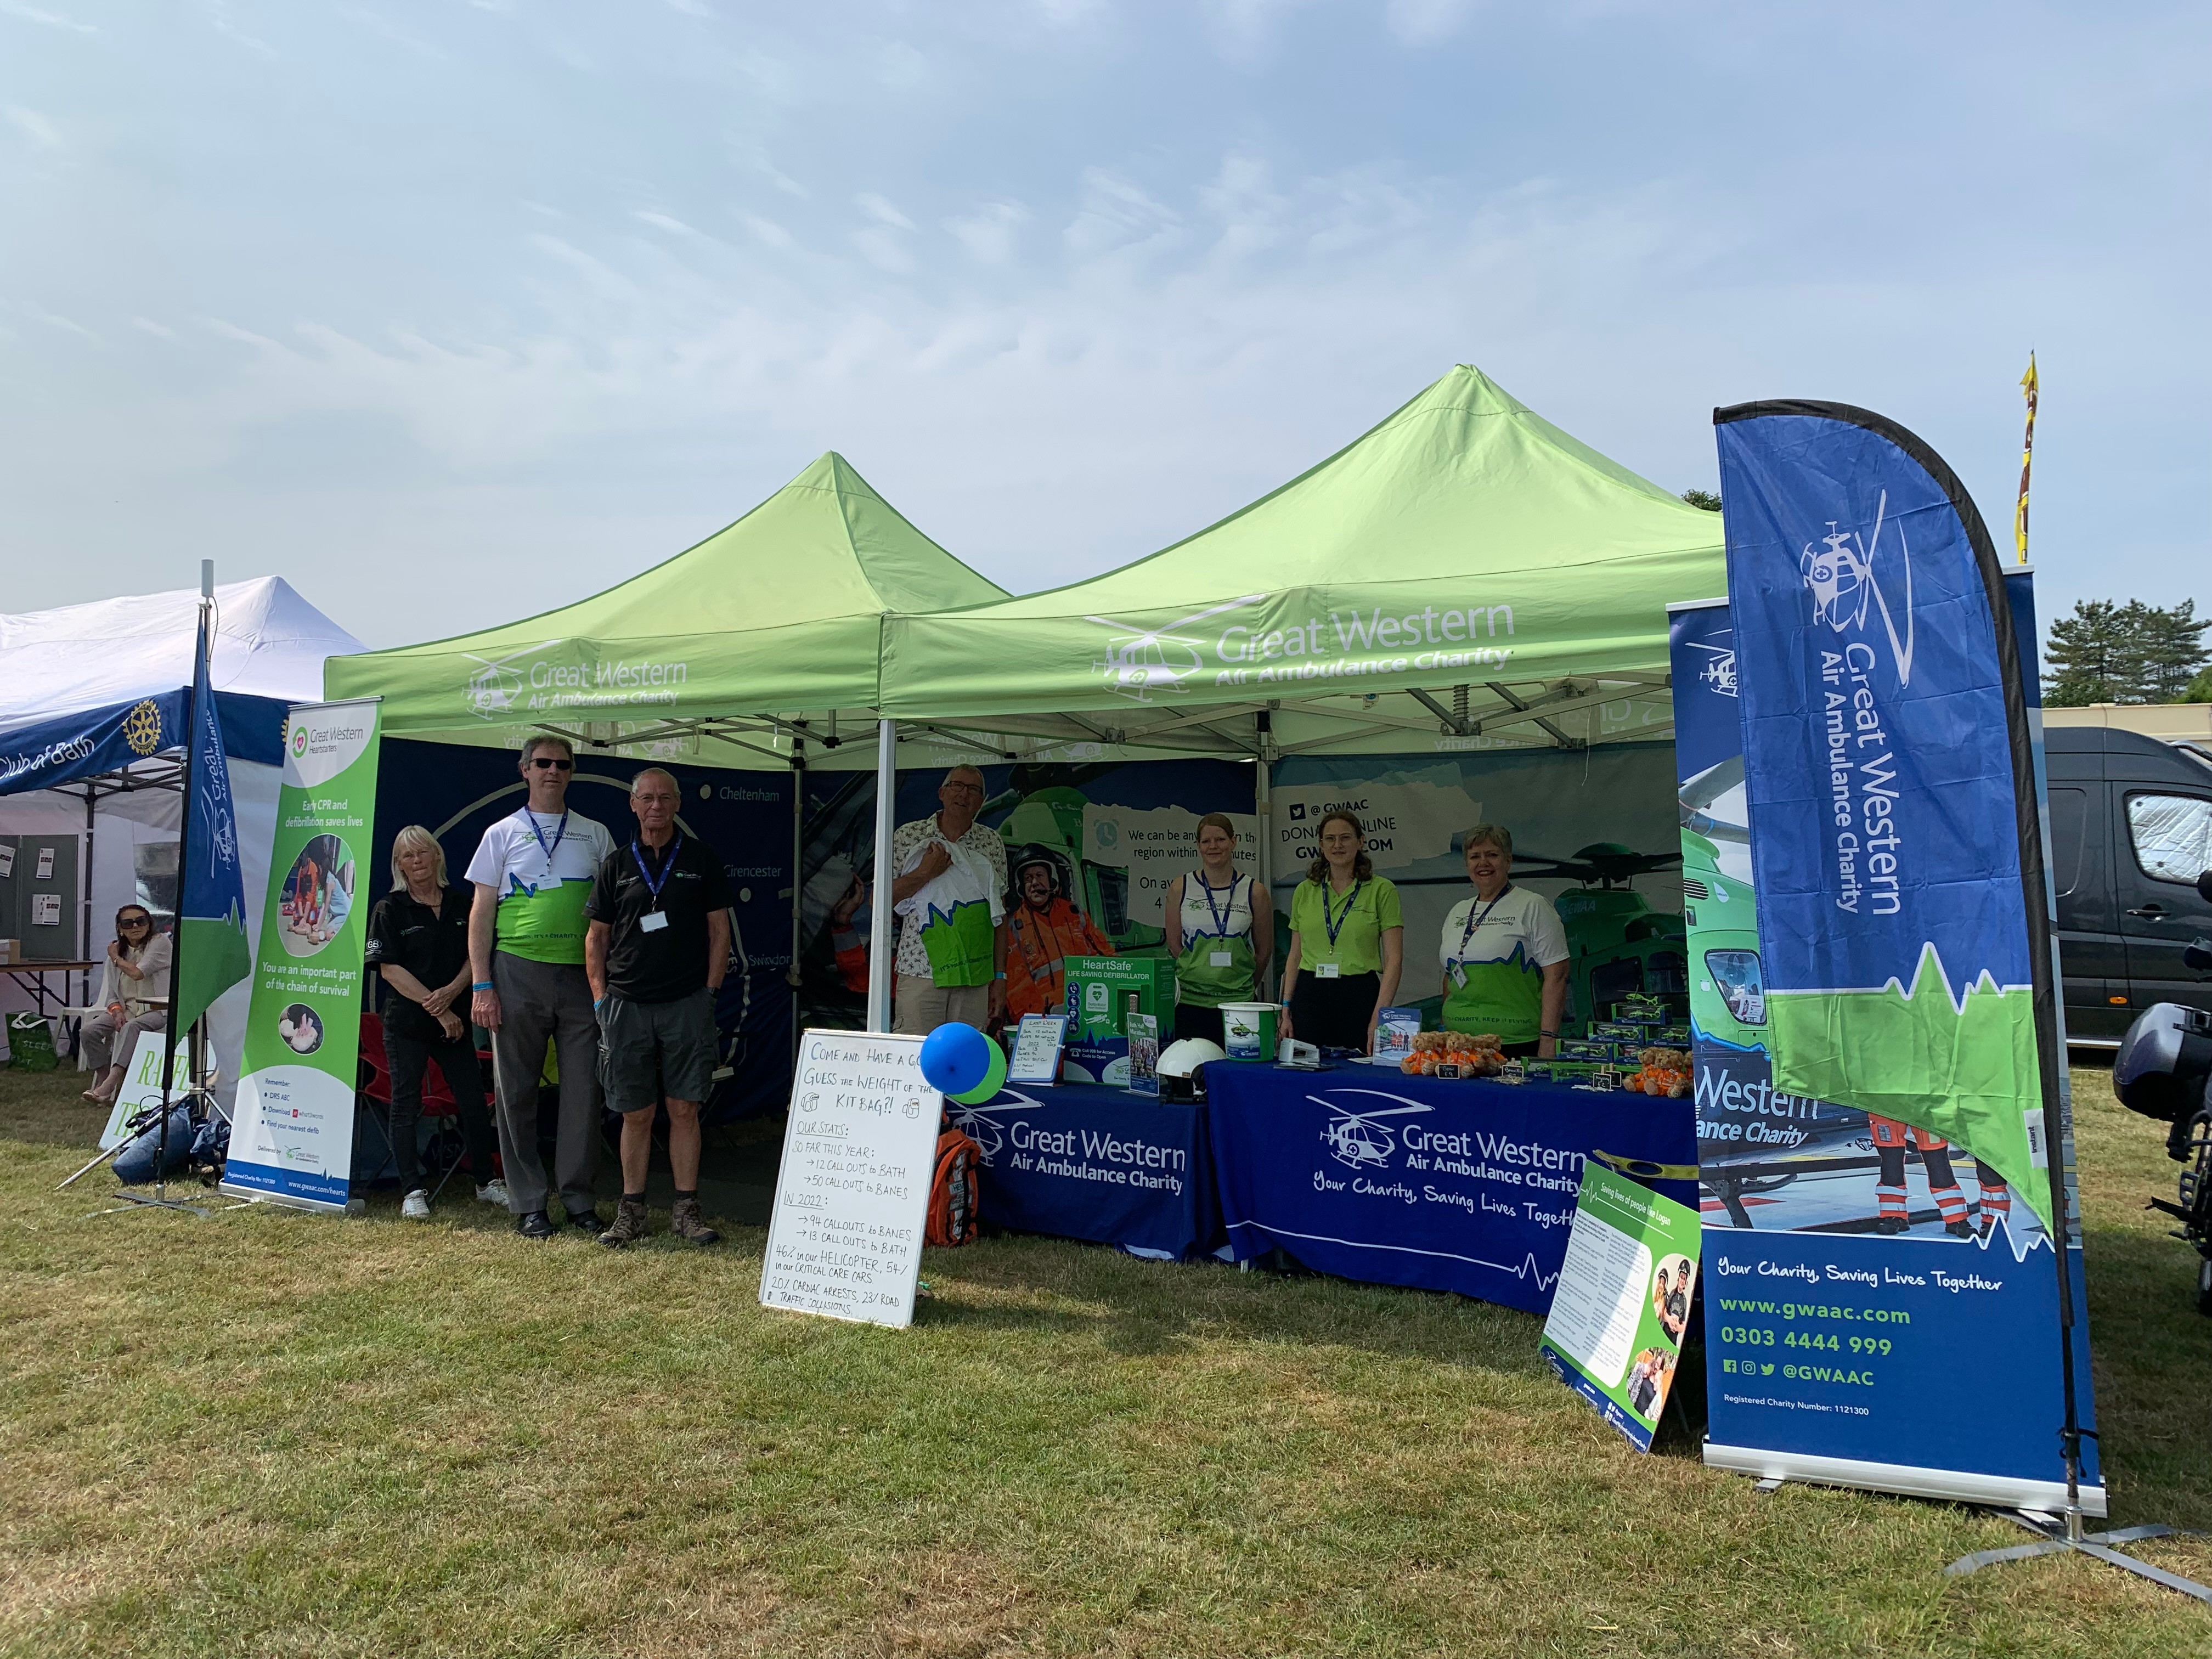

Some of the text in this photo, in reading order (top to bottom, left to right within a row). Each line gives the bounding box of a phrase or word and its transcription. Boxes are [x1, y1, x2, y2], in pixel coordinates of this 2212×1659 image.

[1216, 603, 1516, 663] Great Western
[531, 661, 687, 688] Great Western
[1215, 647, 1513, 687] Air Ambulance Charity
[528, 689, 680, 709] Air Ambulance Charity
[310, 726, 363, 743] Great Western
[31, 735, 94, 770] of Bath
[309, 744, 337, 754] Heartstarters
[1820, 650, 1861, 915] Air Ambulance Charity
[1845, 642, 1902, 915] Great Western
[720, 786, 780, 802] Cheltenham
[303, 798, 348, 813] Early CPR and
[1311, 799, 1369, 816] @ GWAAC
[285, 815, 363, 828] defibrillation saves lives
[1128, 830, 1180, 840] We can be
[1134, 847, 1198, 860] region within
[724, 865, 782, 877] Cirencester
[1139, 877, 1156, 889] On
[1155, 897, 1162, 909] 4
[368, 940, 379, 949] GB
[748, 952, 793, 967] Swindon
[1083, 960, 1131, 970] HeartSafe
[262, 962, 357, 982] You are an important part
[1081, 970, 1102, 979] SAVING
[1103, 972, 1150, 980] DEFIBRILLATOR
[266, 978, 350, 996] of the chain of survival
[811, 1042, 904, 1065] COME AND HAVE A
[804, 1067, 933, 1094] GUESS THE WEIGHT OF THE
[280, 1093, 290, 1102] ABC
[835, 1093, 857, 1109] KIT
[268, 1106, 290, 1116] Download
[278, 1122, 287, 1131] your
[288, 1124, 306, 1133] nearest
[307, 1125, 319, 1135] defib
[797, 1121, 819, 1133] OUR
[1746, 1122, 1809, 1149] Charity
[257, 1145, 275, 1154] Delivered
[792, 1141, 842, 1156] SO FAR THIS
[1011, 1121, 1185, 1172] Great Western
[1403, 1124, 1587, 1173] Great Western
[2028, 1126, 2038, 1153] Instant
[816, 1159, 906, 1179] 12 CALL OUTS BATH
[1011, 1153, 1182, 1196] Air Ambulance Charity
[1406, 1154, 1582, 1198] Air Ambulance Charity
[288, 1181, 346, 1197] www.gwaac.com/hearts
[784, 1190, 793, 1205] IN
[811, 1175, 908, 1200] 50 BANES
[1313, 1170, 1516, 1217] Your Charity, Saving Lives
[1601, 1182, 1671, 1226] Saving lives of people like Logan
[810, 1215, 911, 1241] 94 BANES
[776, 1244, 797, 1258] 46%
[810, 1231, 906, 1257] 13 BATH
[795, 1263, 849, 1279] CRITICAL CARE
[1717, 1256, 2004, 1294] Your Charity, Saving Lives Together
[771, 1277, 900, 1307] 20% CARDIAC 23% ROAD
[780, 1291, 851, 1314] TRAFFIC COLLISIONS
[1719, 1298, 1910, 1325] www.gwaac.com
[1721, 1327, 1892, 1356] 0303 4444 999
[1783, 1364, 1874, 1386] @GWAAC
[1724, 1393, 1870, 1415] Registered Charity Number: 1121300
